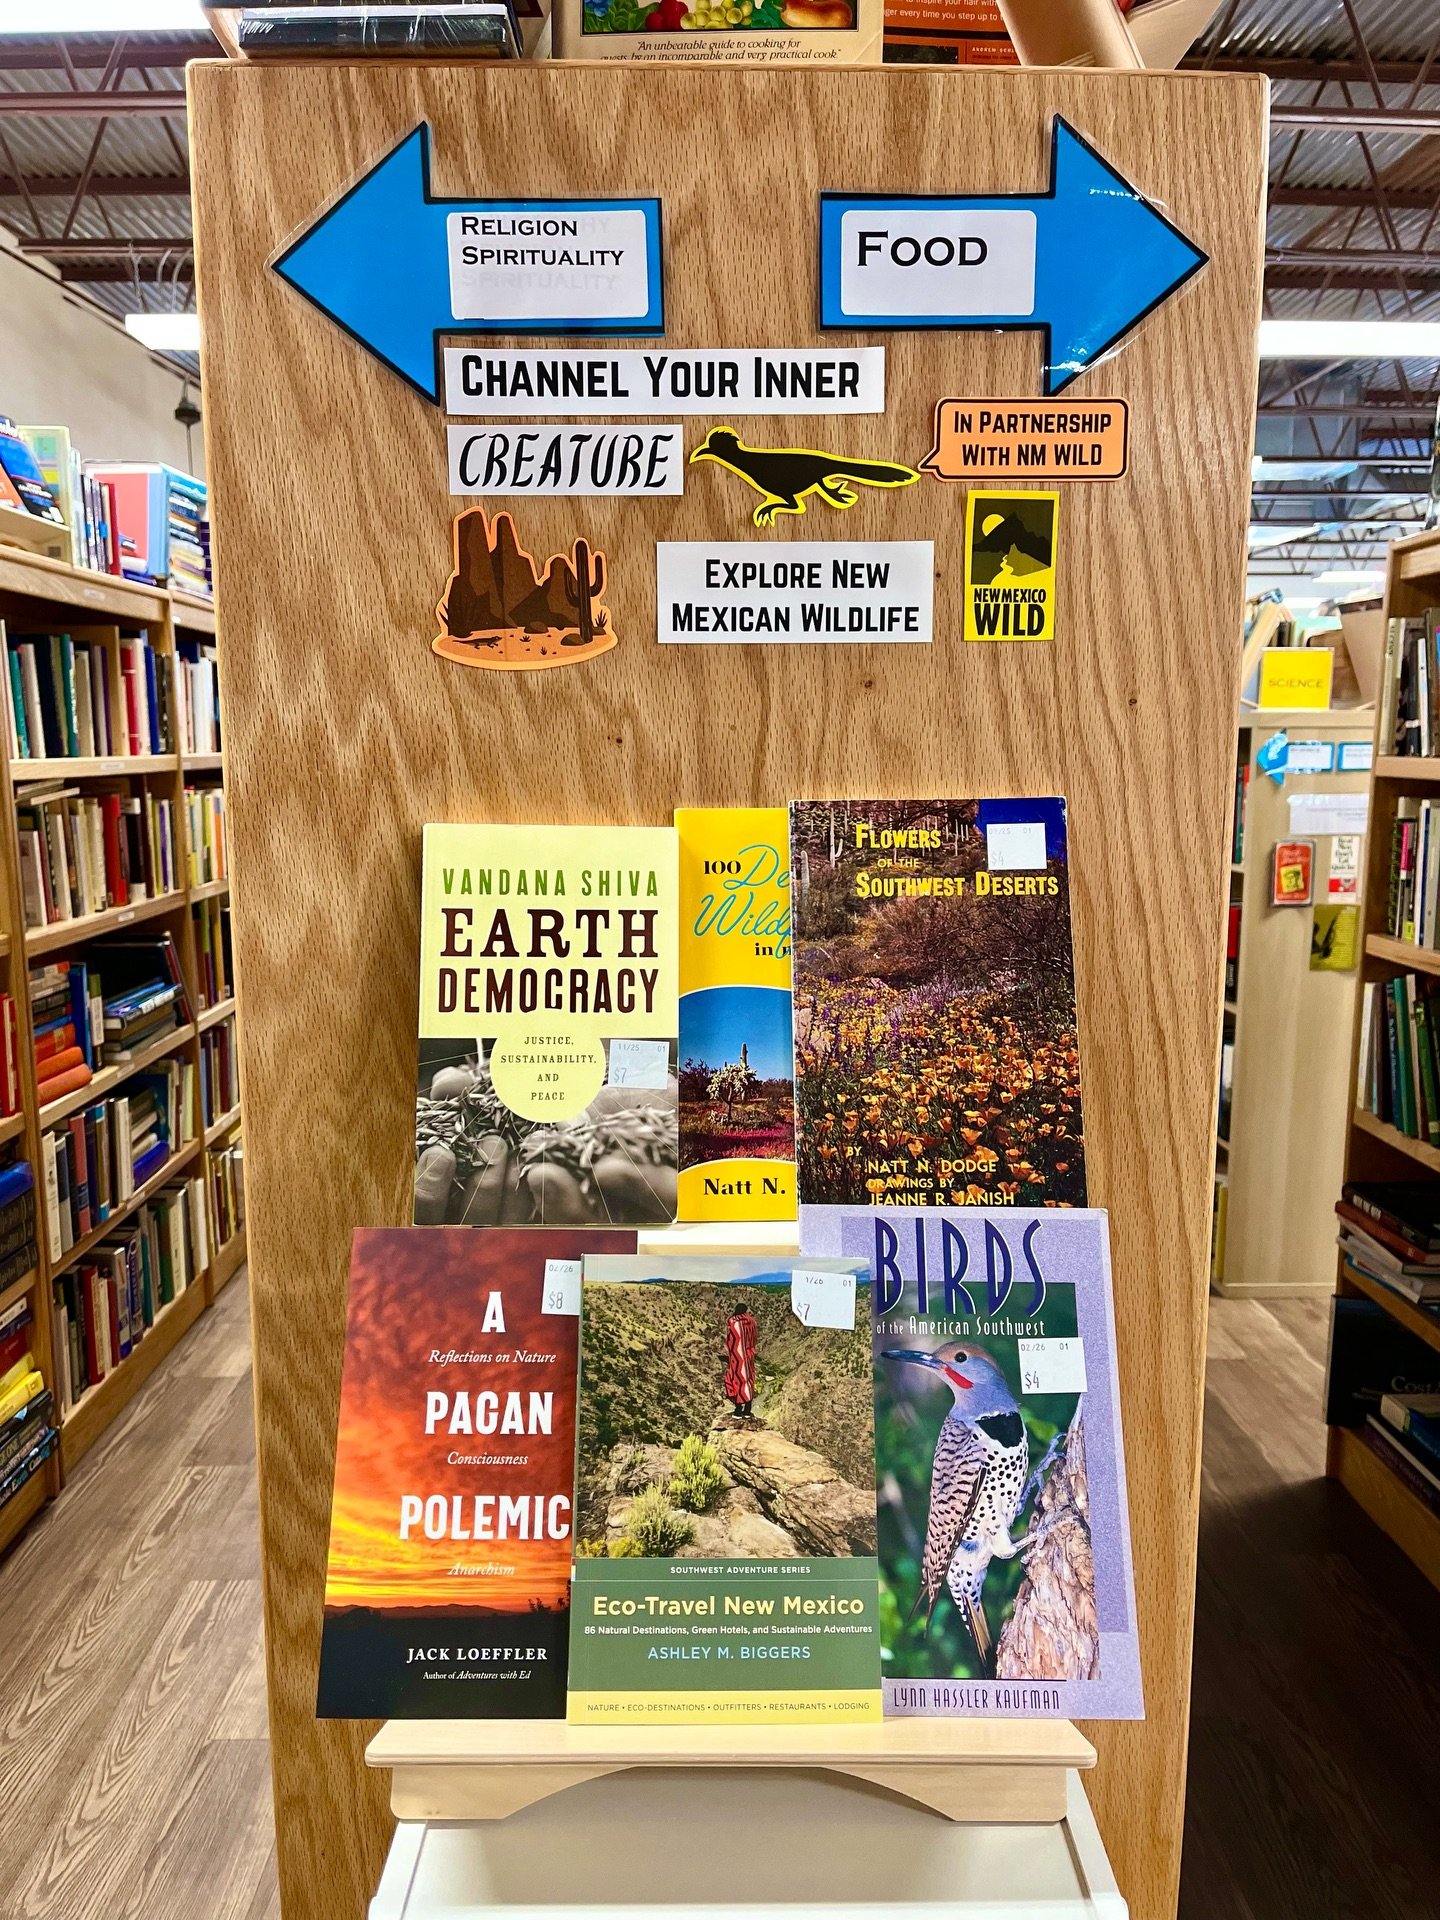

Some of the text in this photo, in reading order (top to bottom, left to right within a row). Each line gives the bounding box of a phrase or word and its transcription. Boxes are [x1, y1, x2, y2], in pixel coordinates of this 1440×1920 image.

[900, 10, 920, 18] every
[922, 10, 940, 18] time
[942, 12, 956, 20] you
[958, 12, 975, 20] step
[654, 40, 707, 50] unbeatable
[709, 39, 735, 51] guide
[748, 39, 785, 50] cooking
[786, 38, 801, 50] for
[659, 51, 723, 60] incomparable
[725, 50, 745, 59] and
[748, 53, 767, 61] very
[770, 49, 812, 60] practical
[459, 432, 674, 489] CREATURE
[1017, 444, 1047, 466] NM
[1054, 444, 1103, 466] WILD
[974, 603, 1045, 636] WILD
[1268, 677, 1325, 689] SCIENCE
[703, 859, 742, 875] 100
[877, 858, 919, 868] OF THE
[443, 868, 658, 897] VANDANA SHIVA
[440, 908, 659, 958] EARTH
[755, 942, 774, 956] in
[438, 967, 659, 1014] DEMOCRACY
[524, 1036, 574, 1046] JUSTICE,
[618, 1043, 640, 1052] 11/25
[500, 1054, 597, 1064] SUSTAINABILITY,
[537, 1073, 559, 1083] AND
[613, 1067, 627, 1084] $7
[530, 1091, 565, 1101] PEACE
[846, 1146, 862, 1157] BY
[868, 1160, 909, 1173] NATT
[941, 1159, 997, 1173] DODGE
[703, 1177, 786, 1195] Natt N.
[868, 1177, 955, 1189] DRAWINGS BY
[869, 1192, 1015, 1206] JEANNE R. JANISH
[875, 1216, 1047, 1318] BIRDS
[842, 1279, 852, 1287] 01
[548, 1291, 563, 1309] $8
[481, 1291, 506, 1333] A
[797, 1302, 810, 1321] $7
[876, 1316, 1046, 1336] of the American Southwest
[1020, 1342, 1069, 1351] 02/26 01
[428, 1350, 556, 1367] Reflections on Nature
[1024, 1370, 1040, 1389] $4
[424, 1390, 553, 1435] PAGAN
[447, 1451, 528, 1465] Consciousness
[400, 1494, 571, 1540] POLEMIC
[448, 1561, 515, 1576] Anarchism
[670, 1566, 811, 1574] SOUTHWEST ADVENTURE SERIES
[593, 1595, 864, 1616] Eco-Travel New Mexico
[584, 1625, 873, 1636] 86 Natural Destinations, Green Hotels, and Sustainable Adventures
[406, 1648, 547, 1664] JACK LOEFFLER
[647, 1646, 811, 1659] ASHLEY M. BIGGERS
[423, 1670, 532, 1680] Author of Adventures with Ed
[894, 1687, 1061, 1710] LYNN HASSLER KAUFMAN
[587, 1702, 870, 1712] NATURE ECO-DESTINATIONS OUTFITTERS RESTAURANTS LODGING
